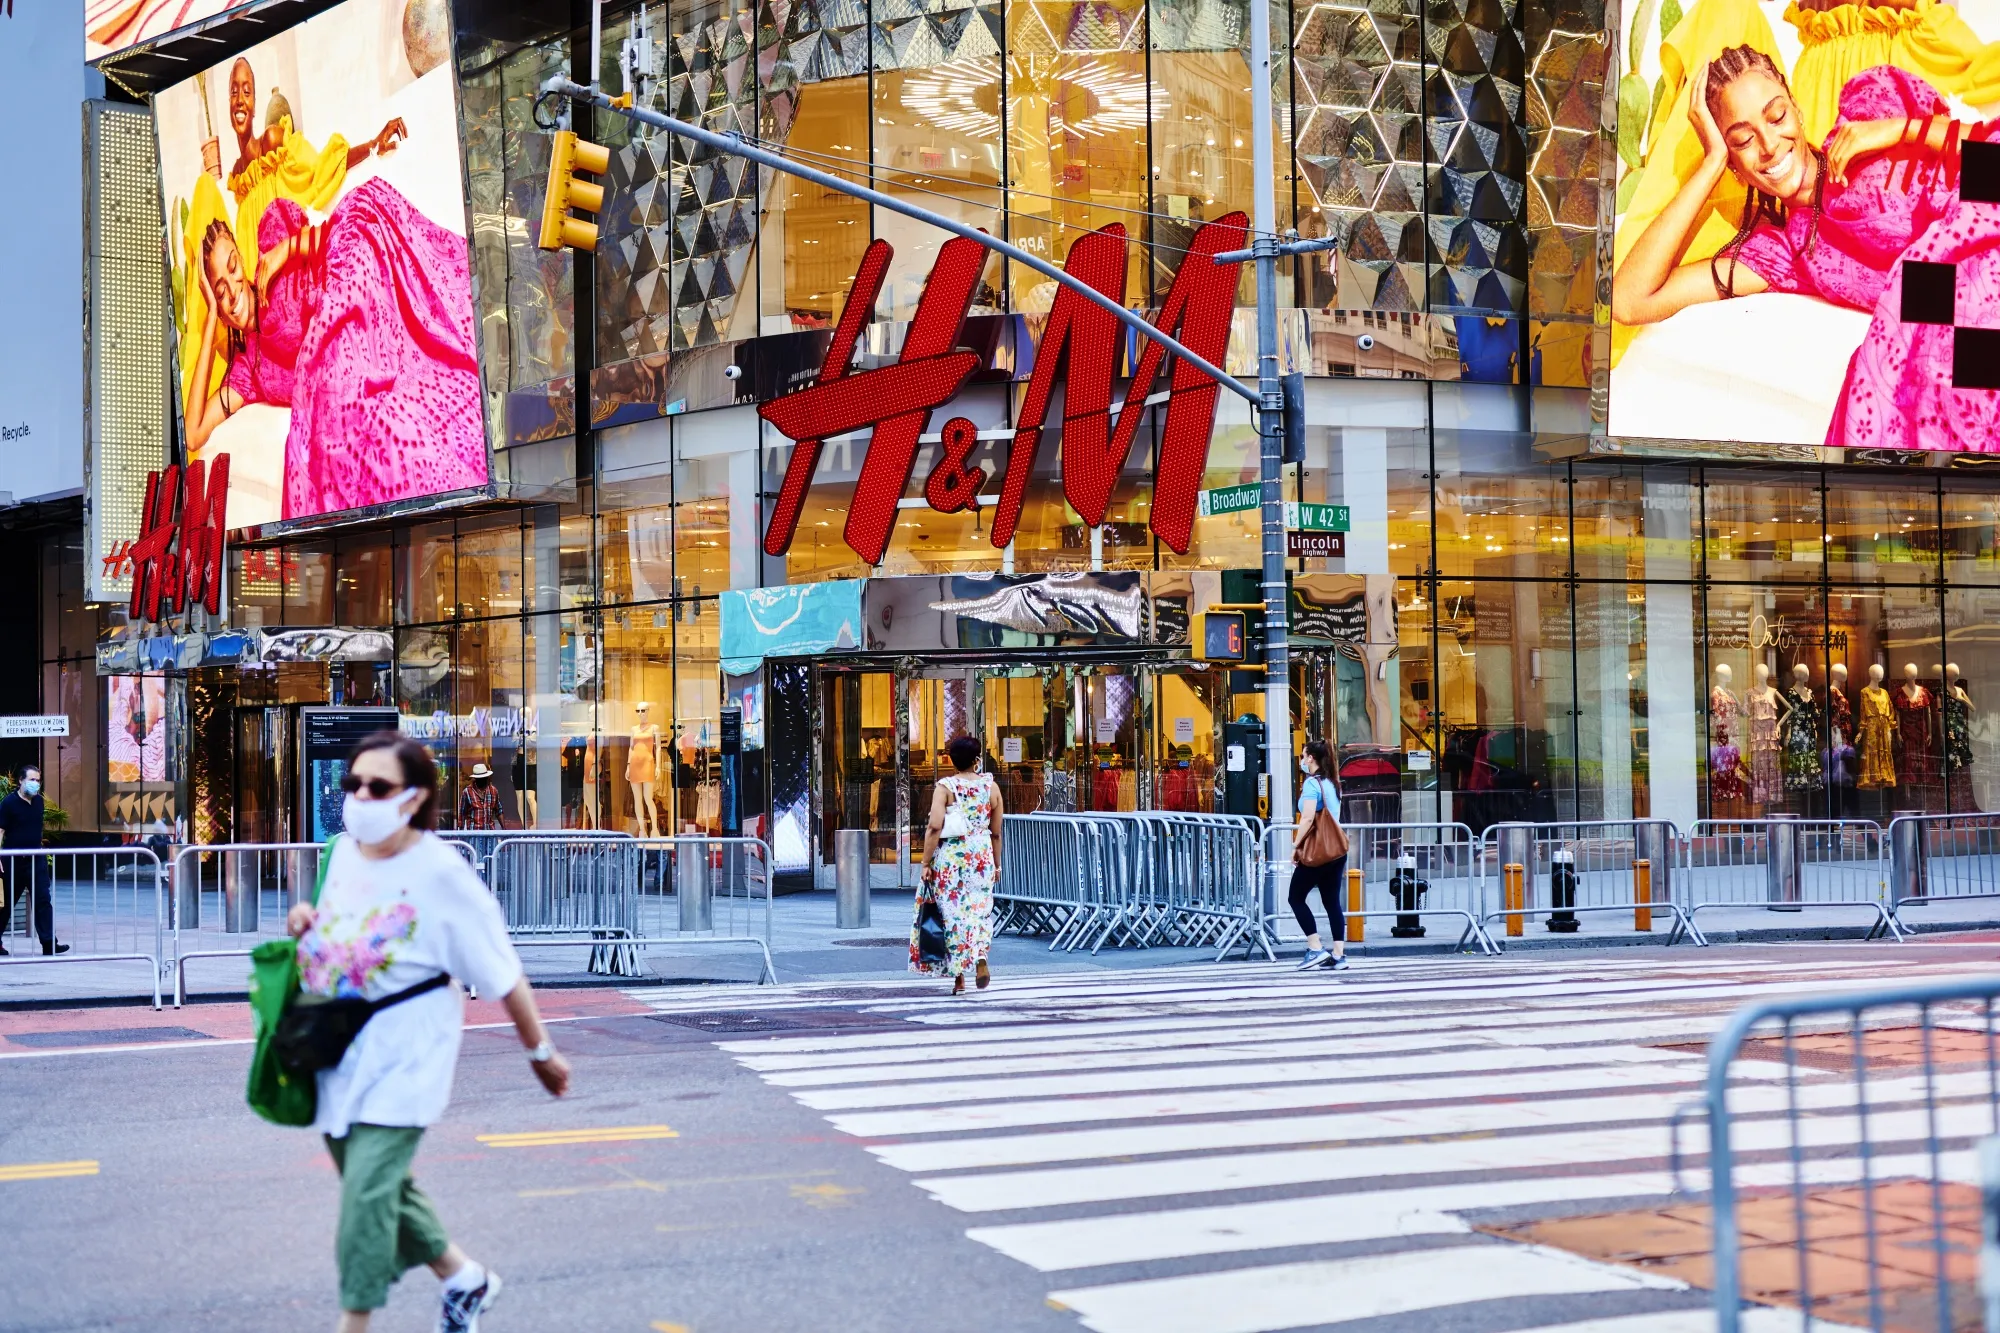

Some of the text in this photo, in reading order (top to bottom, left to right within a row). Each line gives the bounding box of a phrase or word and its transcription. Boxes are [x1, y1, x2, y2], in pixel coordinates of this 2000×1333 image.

[756, 211, 1249, 565] H&M
[2, 421, 31, 442] Recycle.
[1213, 488, 1261, 511] Broadway
[1302, 507, 1313, 526] W
[1319, 508, 1334, 527] 42
[1339, 509, 1348, 522] St
[128, 453, 230, 623] H&M
[1291, 535, 1340, 550] Lincoln
[1302, 549, 1329, 557] Highway
